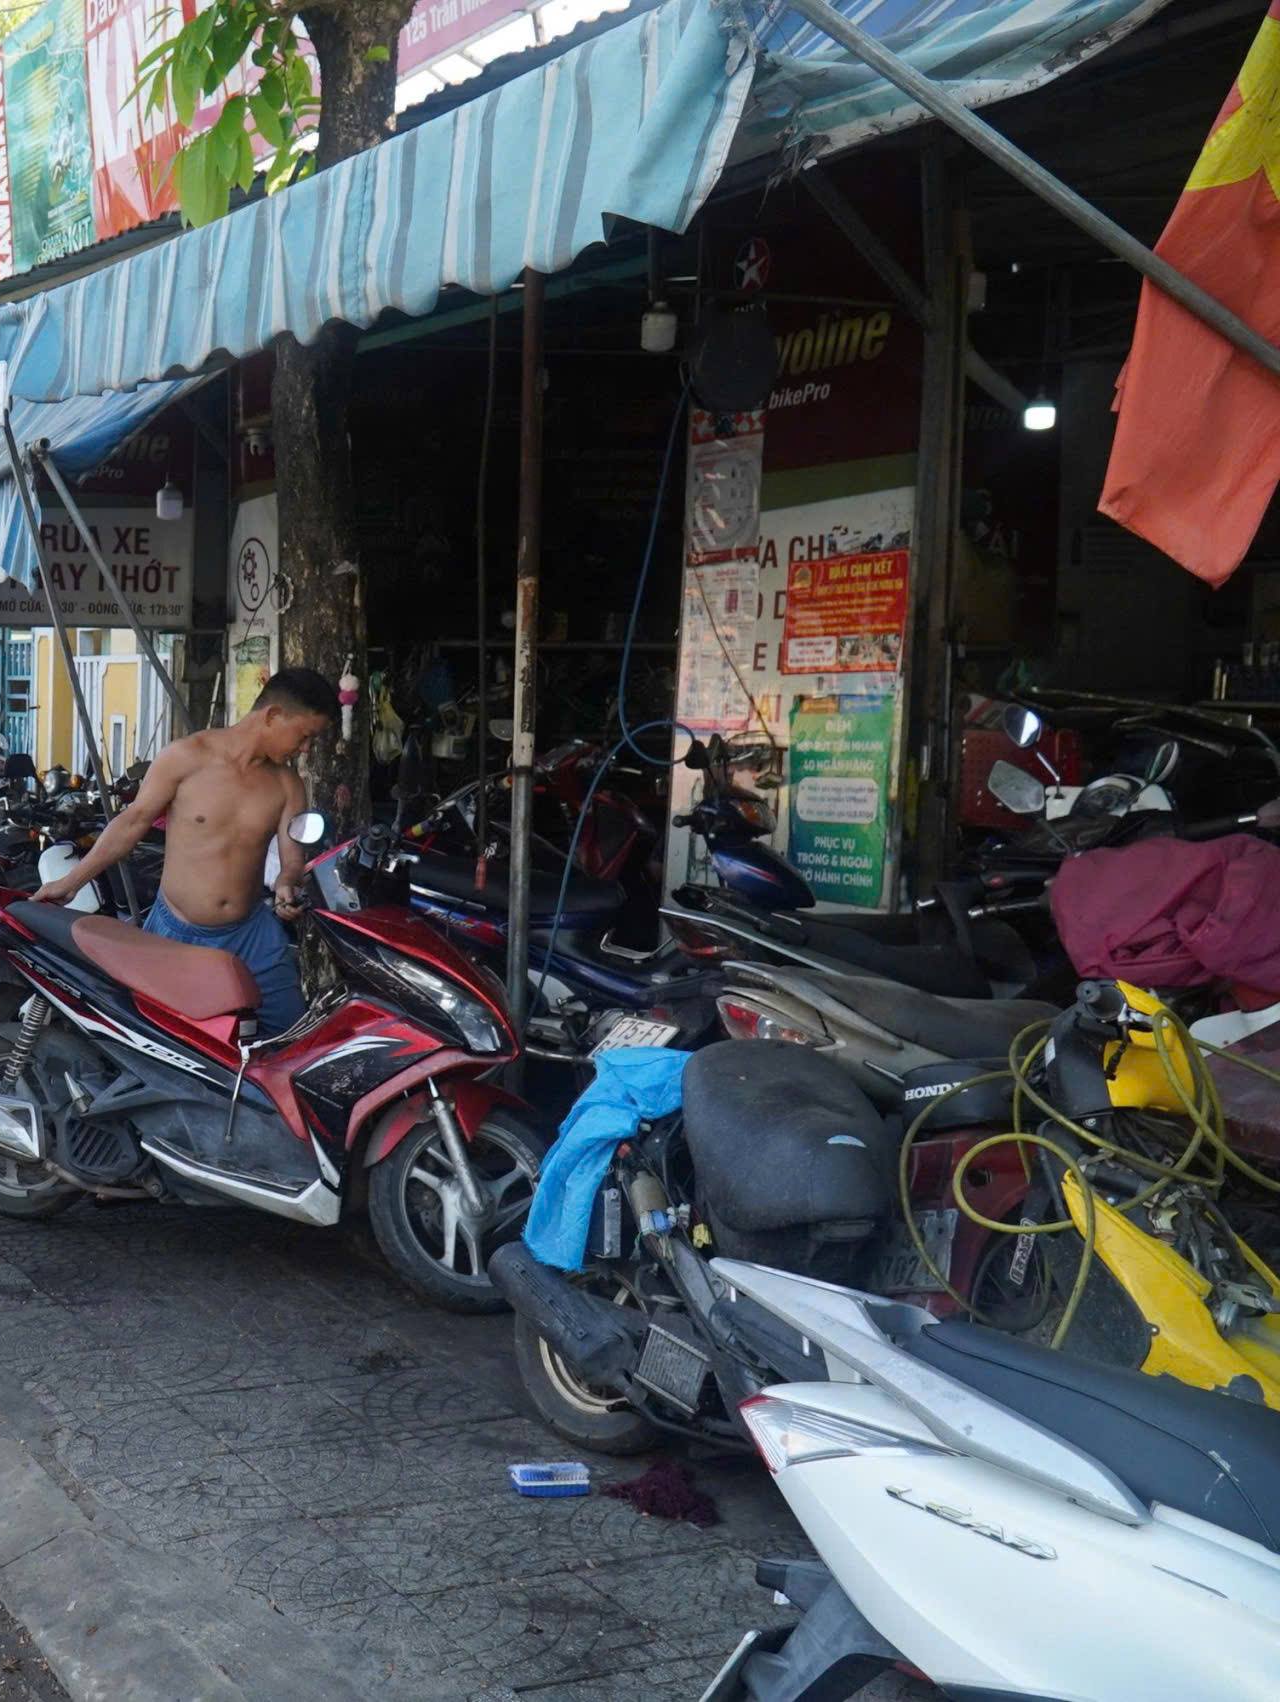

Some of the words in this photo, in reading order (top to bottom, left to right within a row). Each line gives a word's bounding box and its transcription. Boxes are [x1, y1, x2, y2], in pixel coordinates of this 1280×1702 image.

[776, 309, 892, 378] voline
[112, 527, 151, 555] XE
[814, 836, 840, 851] PHỤC
[797, 852, 830, 866] TRONG
[815, 868, 841, 885] HÀNH
